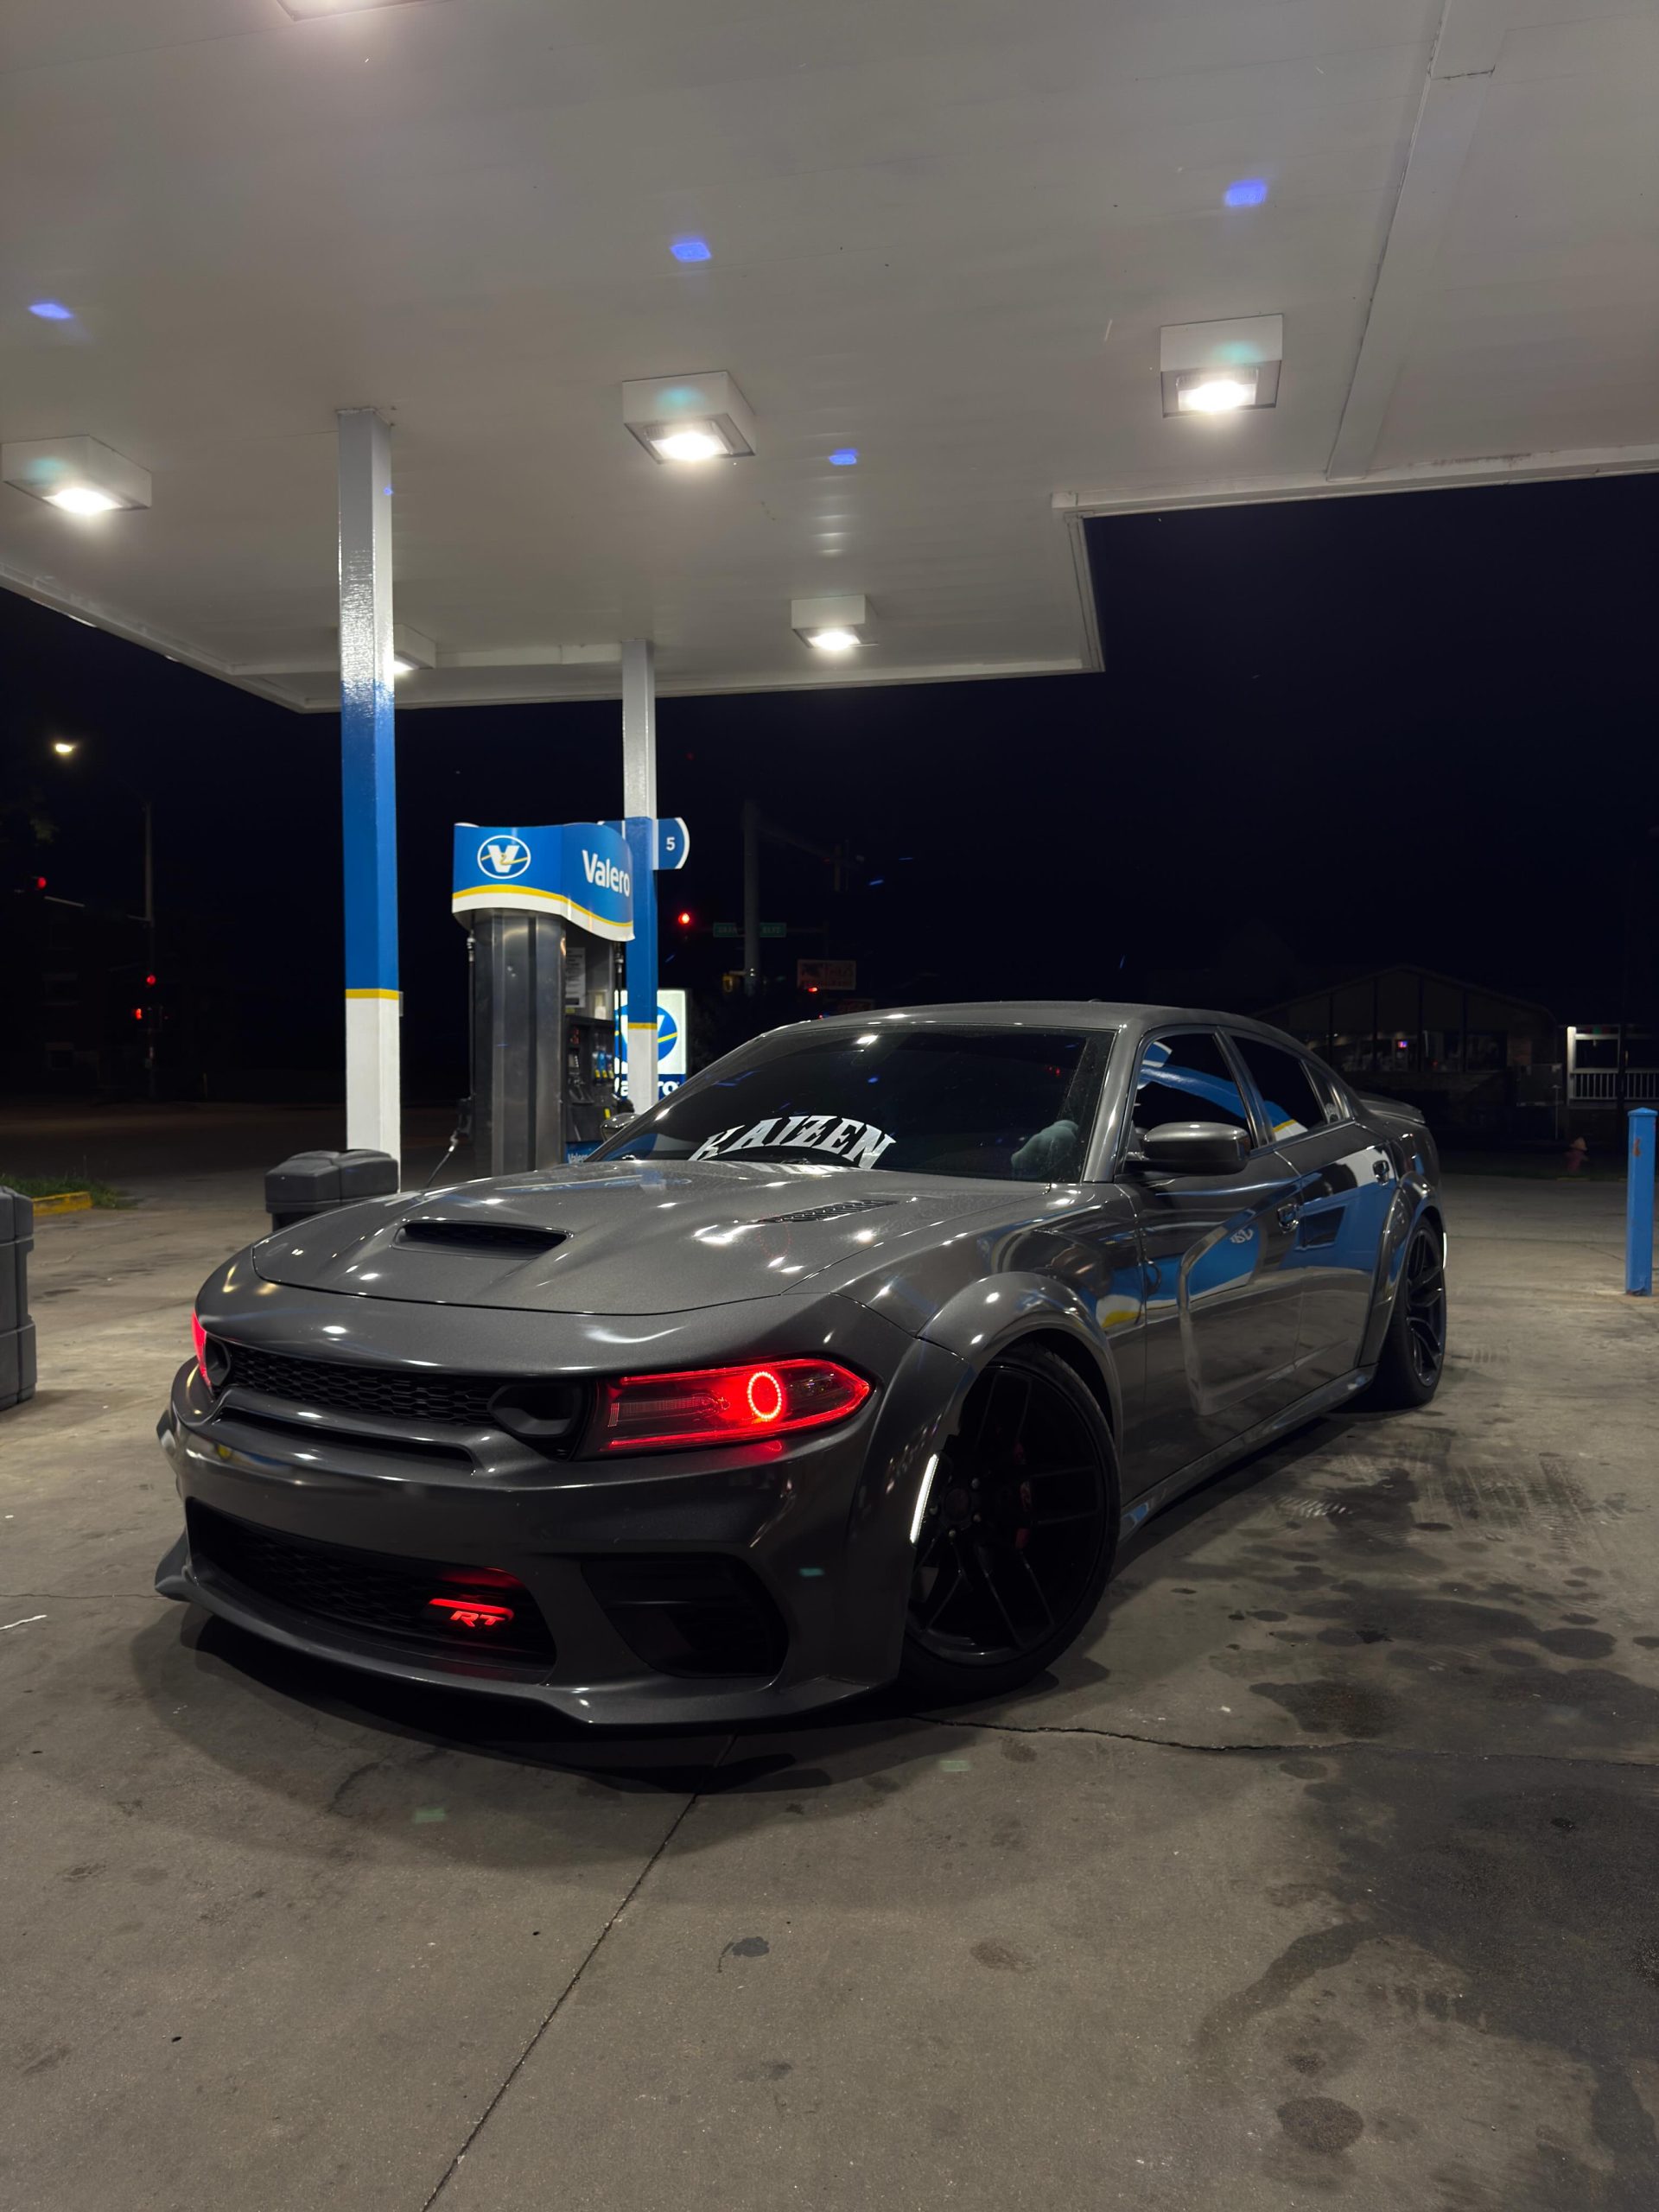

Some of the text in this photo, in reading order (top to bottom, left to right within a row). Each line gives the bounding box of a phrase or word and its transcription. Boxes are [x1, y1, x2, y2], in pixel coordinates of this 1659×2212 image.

[665, 836, 676, 851] 5
[582, 849, 630, 897] Valero
[688, 1115, 897, 1170] KAIZEN
[450, 1610, 505, 1627] RT
